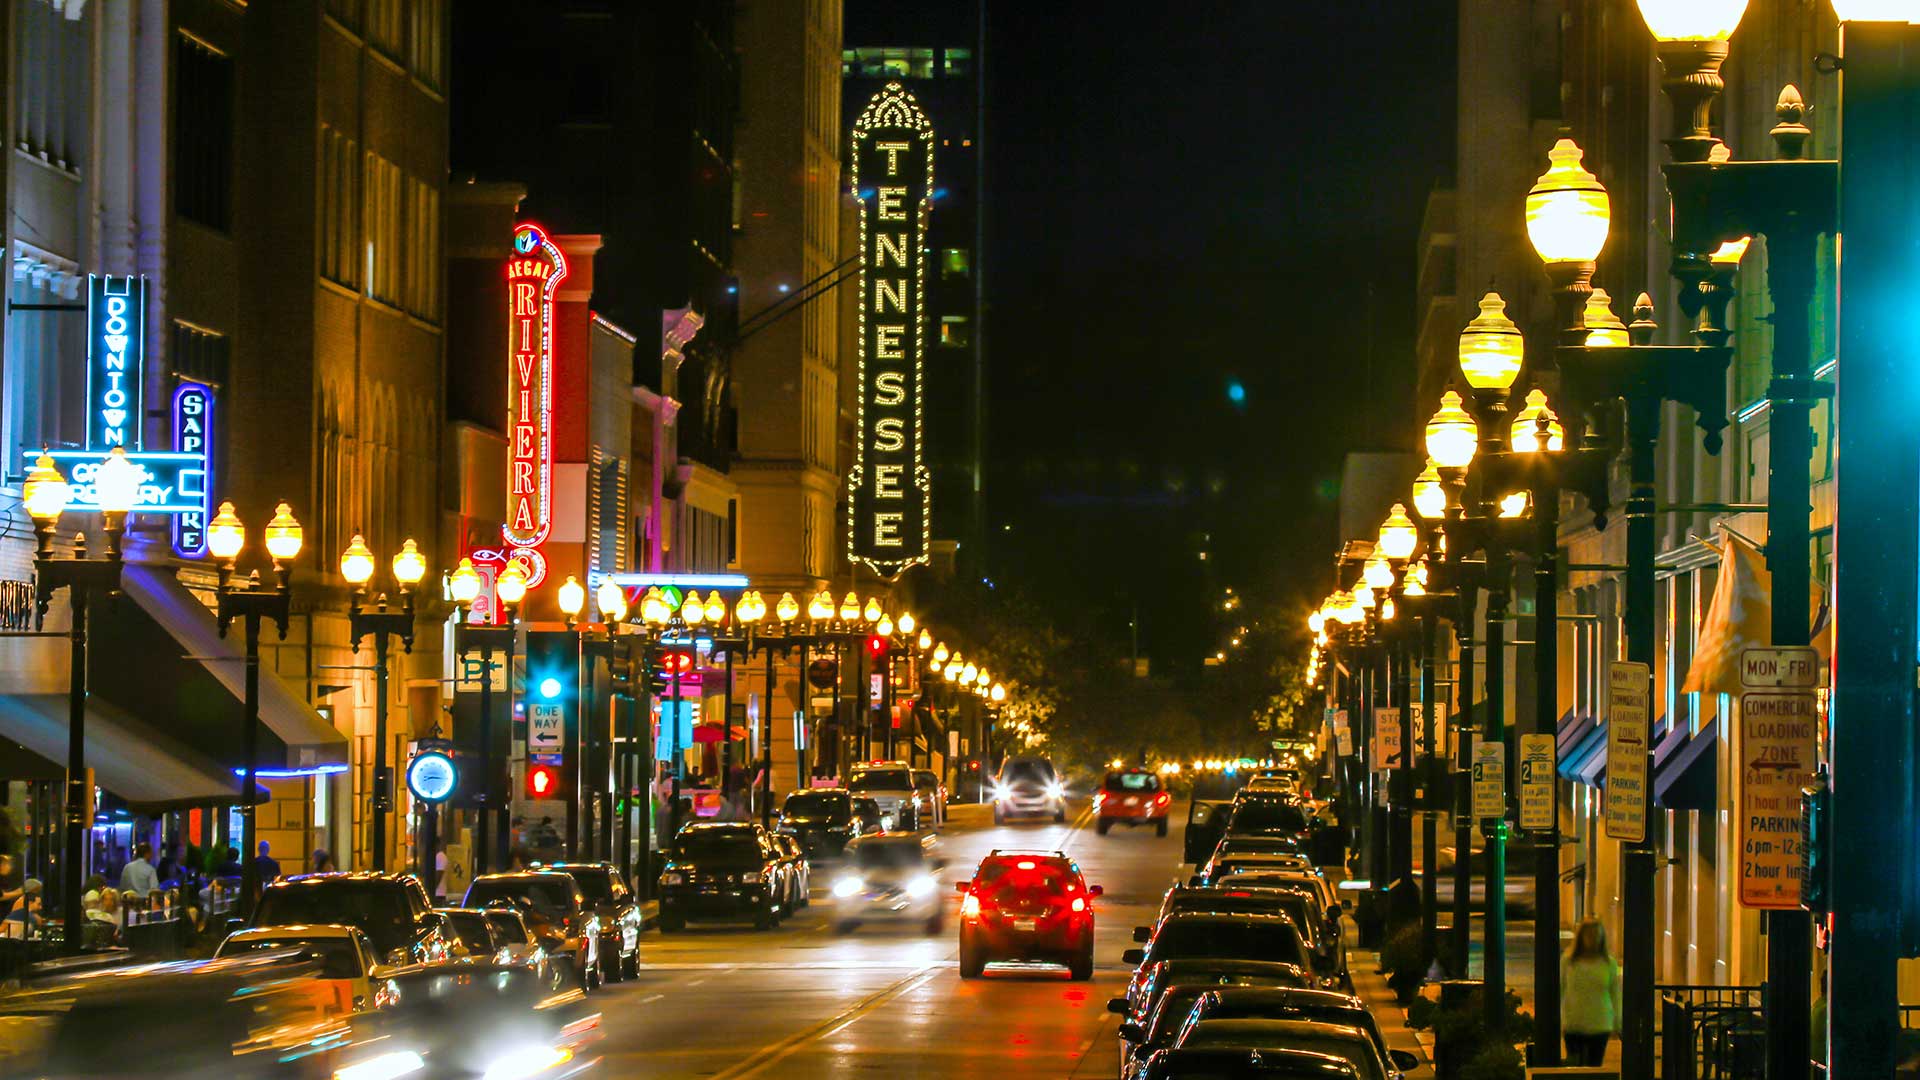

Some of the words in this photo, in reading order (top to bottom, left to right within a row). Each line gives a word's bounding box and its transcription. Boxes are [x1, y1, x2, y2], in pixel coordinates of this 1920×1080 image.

[873, 141, 910, 547] TENNESSEE
[102, 297, 129, 446] DOWNTOWN
[513, 283, 538, 530] RIVIERA
[535, 706, 559, 716] ONE
[1745, 700, 1811, 716] COMMERCIAL
[534, 719, 559, 729] WAY
[1612, 710, 1645, 724] LOADING
[1617, 727, 1639, 738] ZONE
[1749, 723, 1809, 739] LOADING
[1384, 736, 1399, 746] RE
[1760, 746, 1800, 761] ZONE
[1474, 765, 1482, 780] 2
[1522, 764, 1530, 781] 2
[1611, 776, 1641, 791] PARKING
[1755, 794, 1780, 811] hour
[1750, 815, 1801, 833] PARKIN
[1744, 862, 1752, 878] 2
[1755, 862, 1780, 878] hour
[1786, 862, 1803, 879] lim
